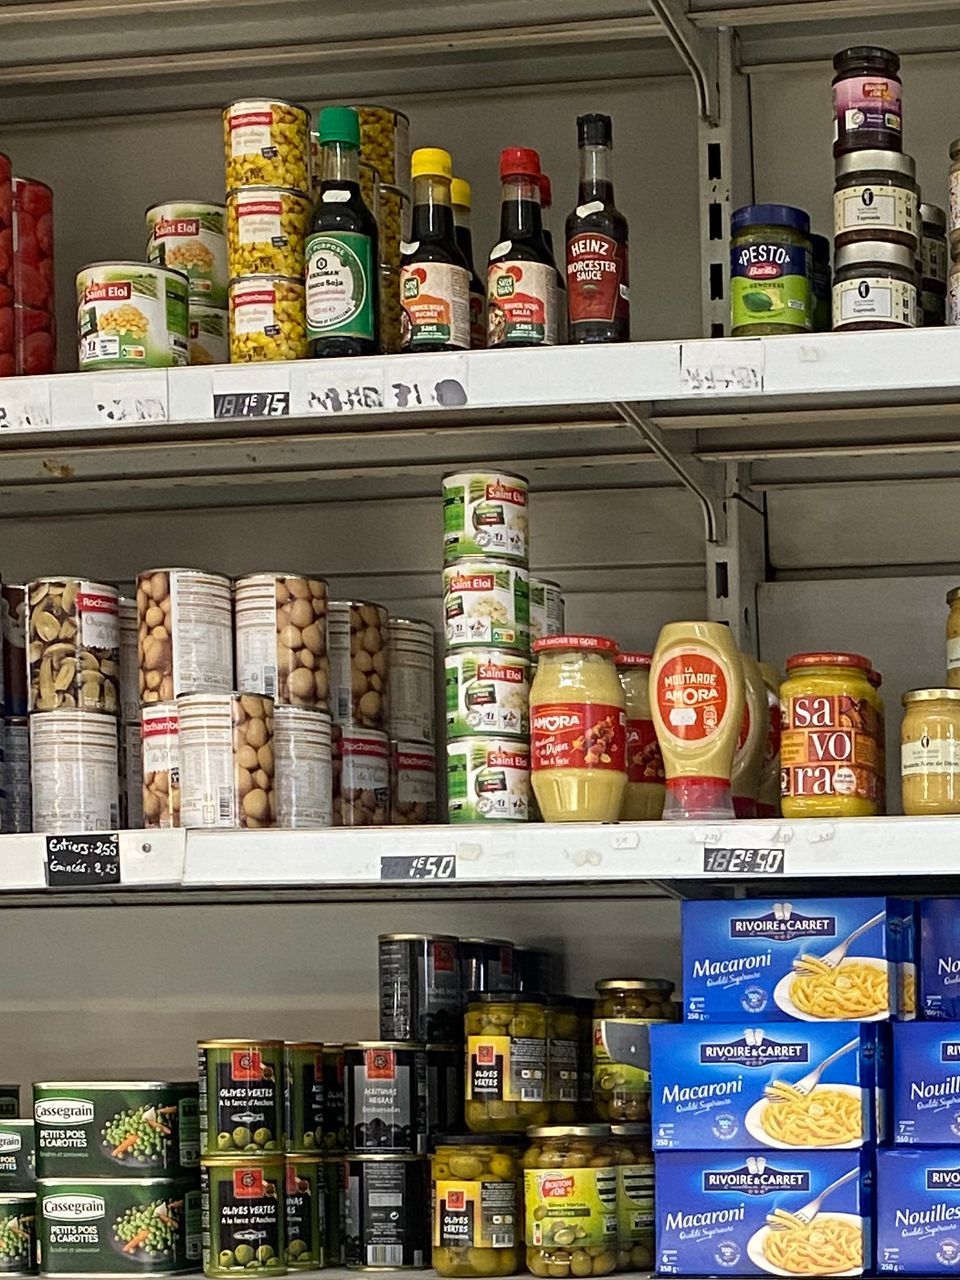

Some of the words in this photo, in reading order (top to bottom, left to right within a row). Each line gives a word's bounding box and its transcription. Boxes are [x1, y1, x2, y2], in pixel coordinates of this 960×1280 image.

[154, 221, 175, 235] Saint
[177, 221, 196, 234] Eloi
[570, 240, 609, 255] HEINZ
[742, 246, 786, 264] PESTO
[577, 269, 602, 281] SAUCE
[749, 266, 778, 276] Barilla
[85, 285, 106, 300] Saint
[108, 285, 128, 297] Eloi
[488, 486, 511, 499] Saint
[451, 578, 471, 590] Saint
[472, 577, 490, 589] Eloi
[480, 666, 501, 679] Saint
[502, 668, 522, 680] Eloi
[664, 673, 717, 686] MOUTARDE
[664, 687, 718, 704] AMORA
[795, 699, 834, 727] sa
[534, 714, 580, 731] AMORA
[812, 732, 850, 760] vo
[490, 753, 512, 765] Saint
[795, 767, 834, 795] ra
[693, 950, 772, 977] Macaroni
[662, 1078, 743, 1104] Macaroni
[36, 1105, 92, 1117] Cassegrain
[40, 1131, 63, 1139] PETITS
[66, 1131, 86, 1139] POIS
[48, 1139, 87, 1147] CAROTTES
[45, 1201, 103, 1213] Cassegrain
[666, 1206, 744, 1231] Macaroni
[51, 1226, 74, 1234] PETITS
[76, 1226, 97, 1234] POIS
[58, 1234, 98, 1242] CAROTTES
